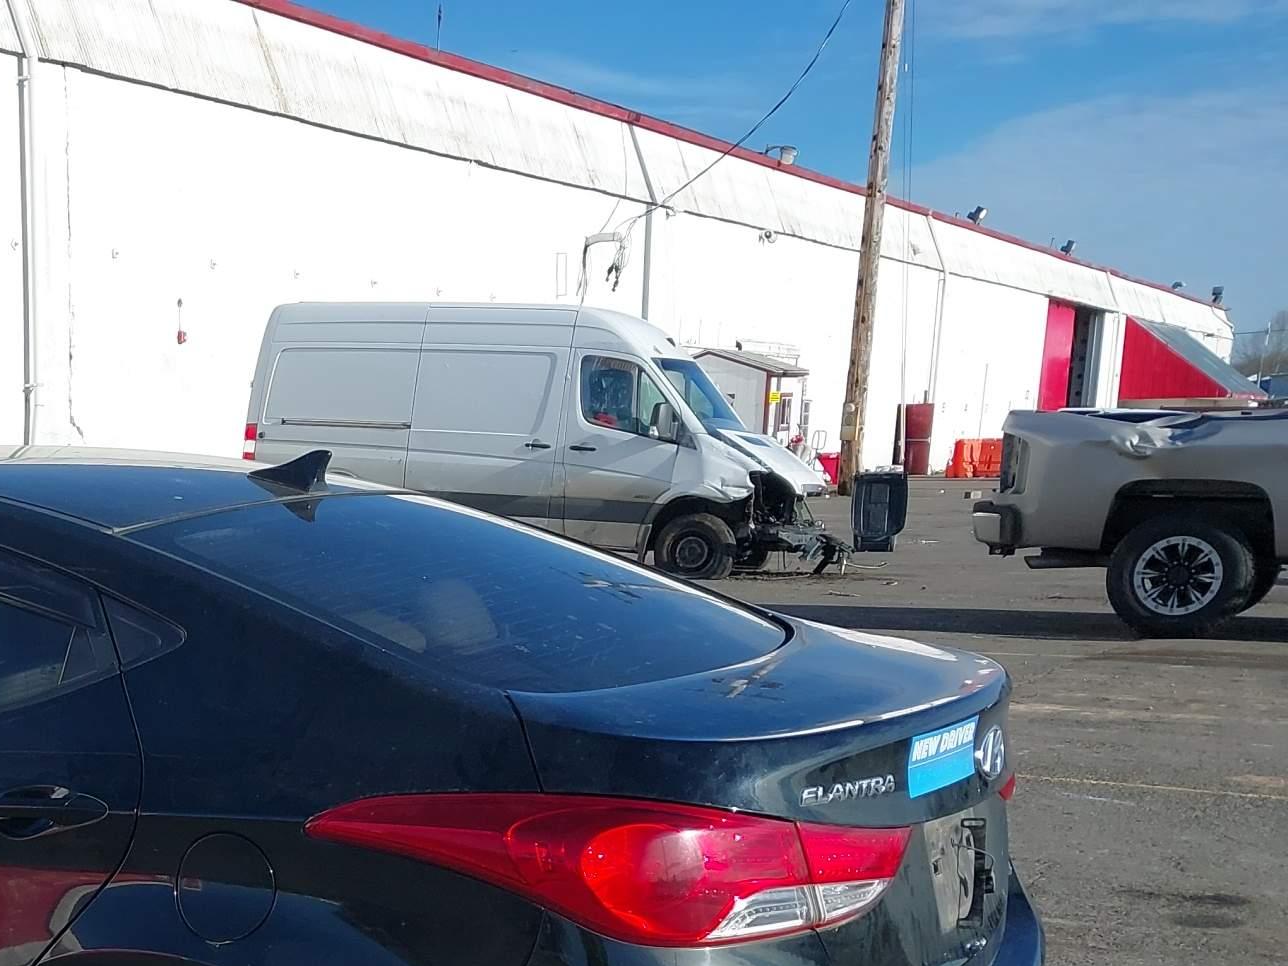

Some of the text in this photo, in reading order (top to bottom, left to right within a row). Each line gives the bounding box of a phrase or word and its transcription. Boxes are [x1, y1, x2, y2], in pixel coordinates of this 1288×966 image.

[912, 721, 976, 761] NEW DRIVER
[800, 774, 895, 806] ELANTRA
